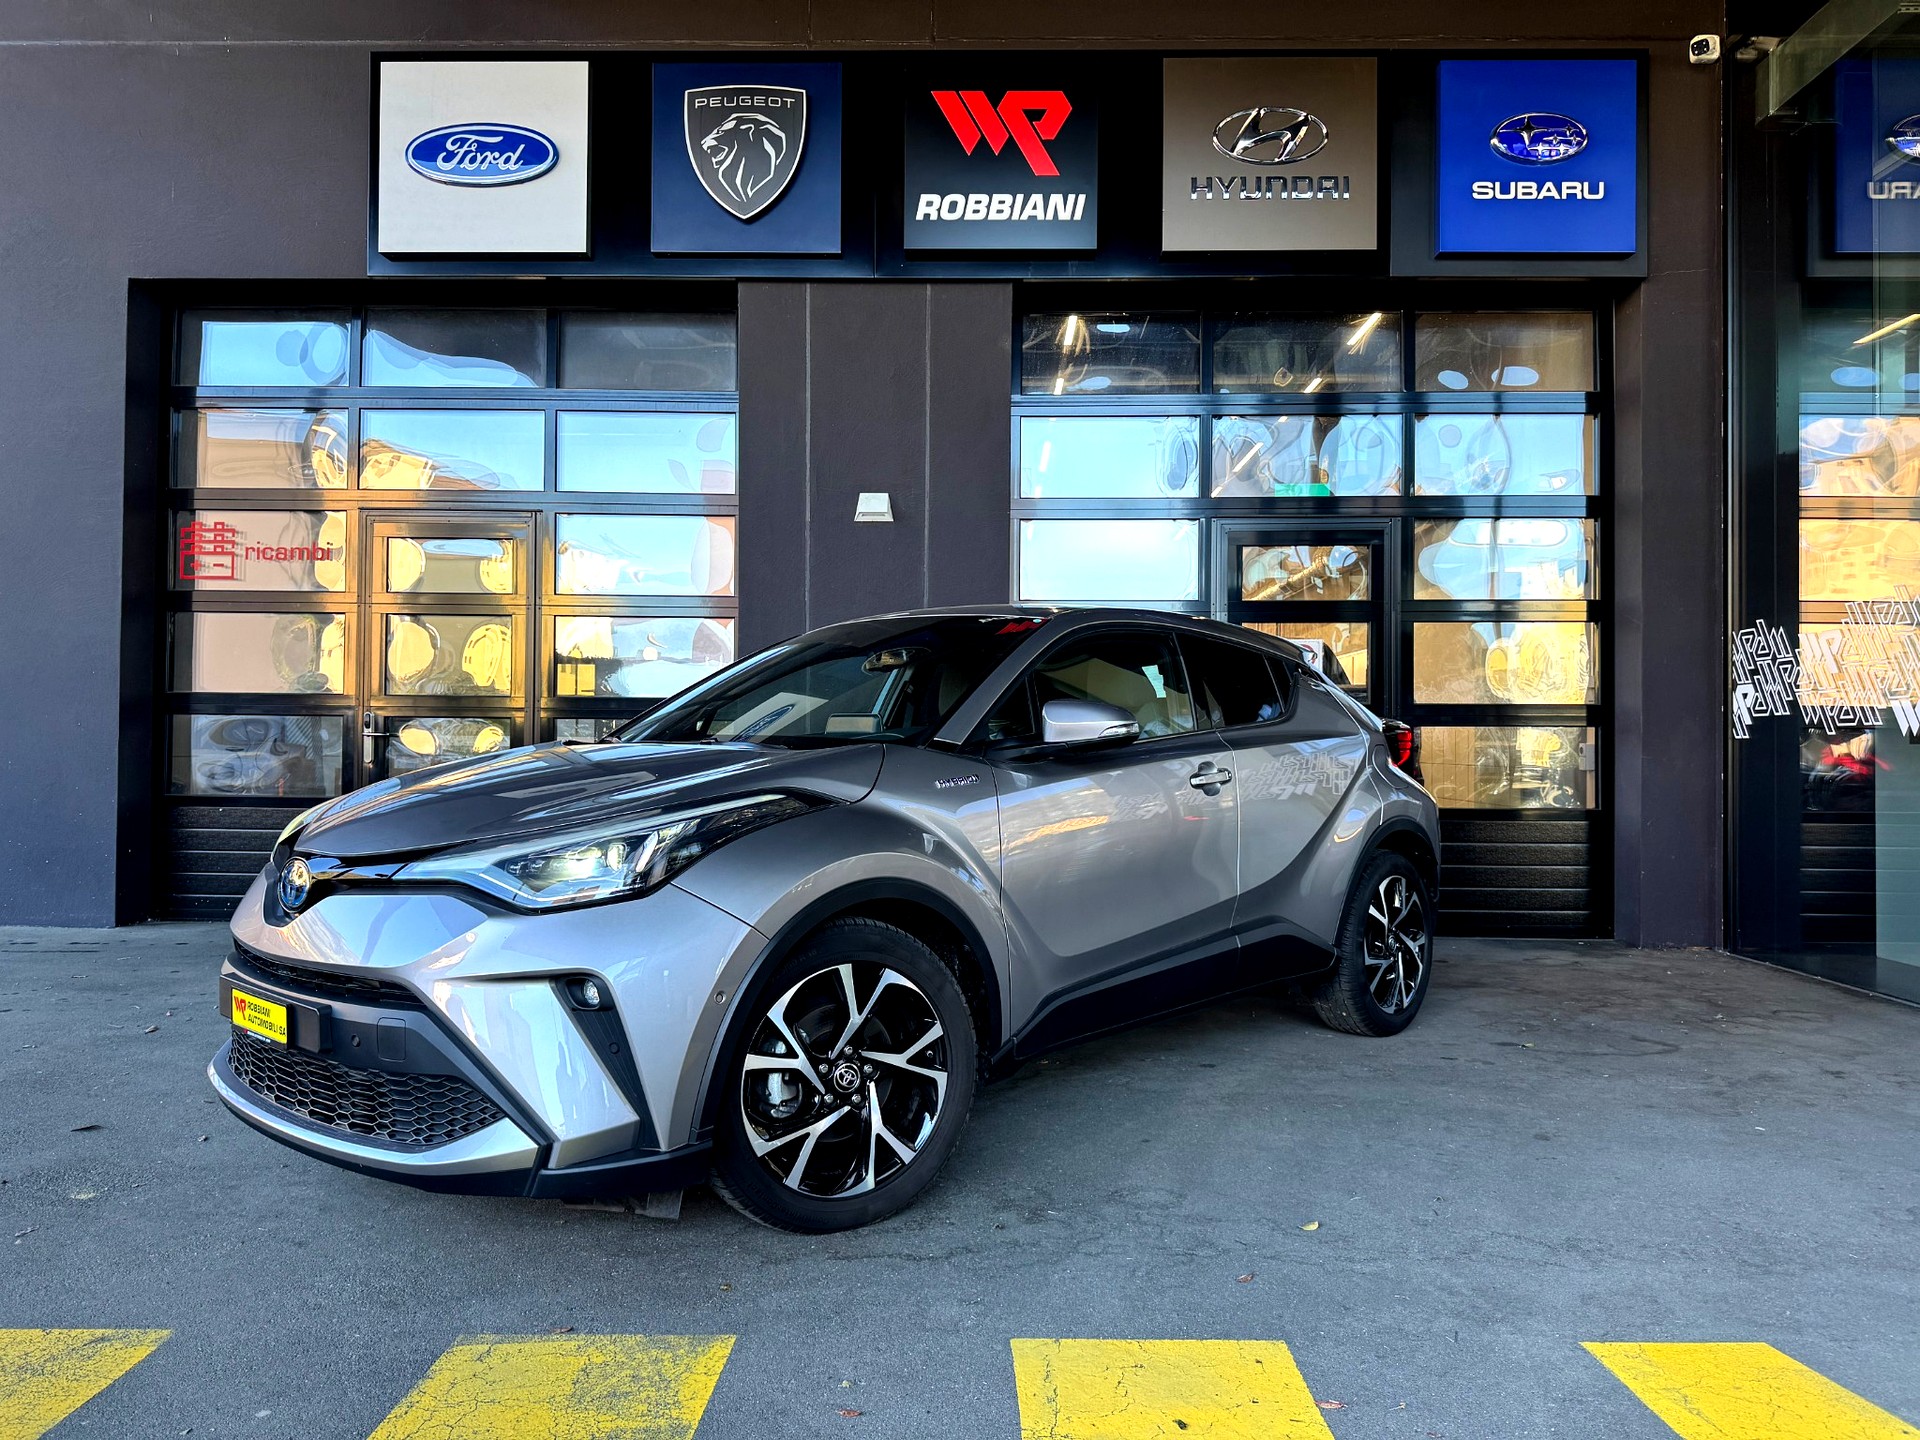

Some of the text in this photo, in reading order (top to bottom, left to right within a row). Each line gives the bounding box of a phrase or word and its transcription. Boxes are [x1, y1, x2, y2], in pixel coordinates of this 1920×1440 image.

[694, 95, 796, 109] PEUGEOT
[437, 134, 525, 170] Ford
[1190, 176, 1350, 200] HYUNDAI
[1471, 181, 1605, 200] SUBARU
[915, 193, 1087, 221] ROBBIANI
[245, 541, 332, 561] ricambi
[247, 1001, 272, 1018] ROBBIANI
[248, 1014, 278, 1033] AUTOMOBILI
